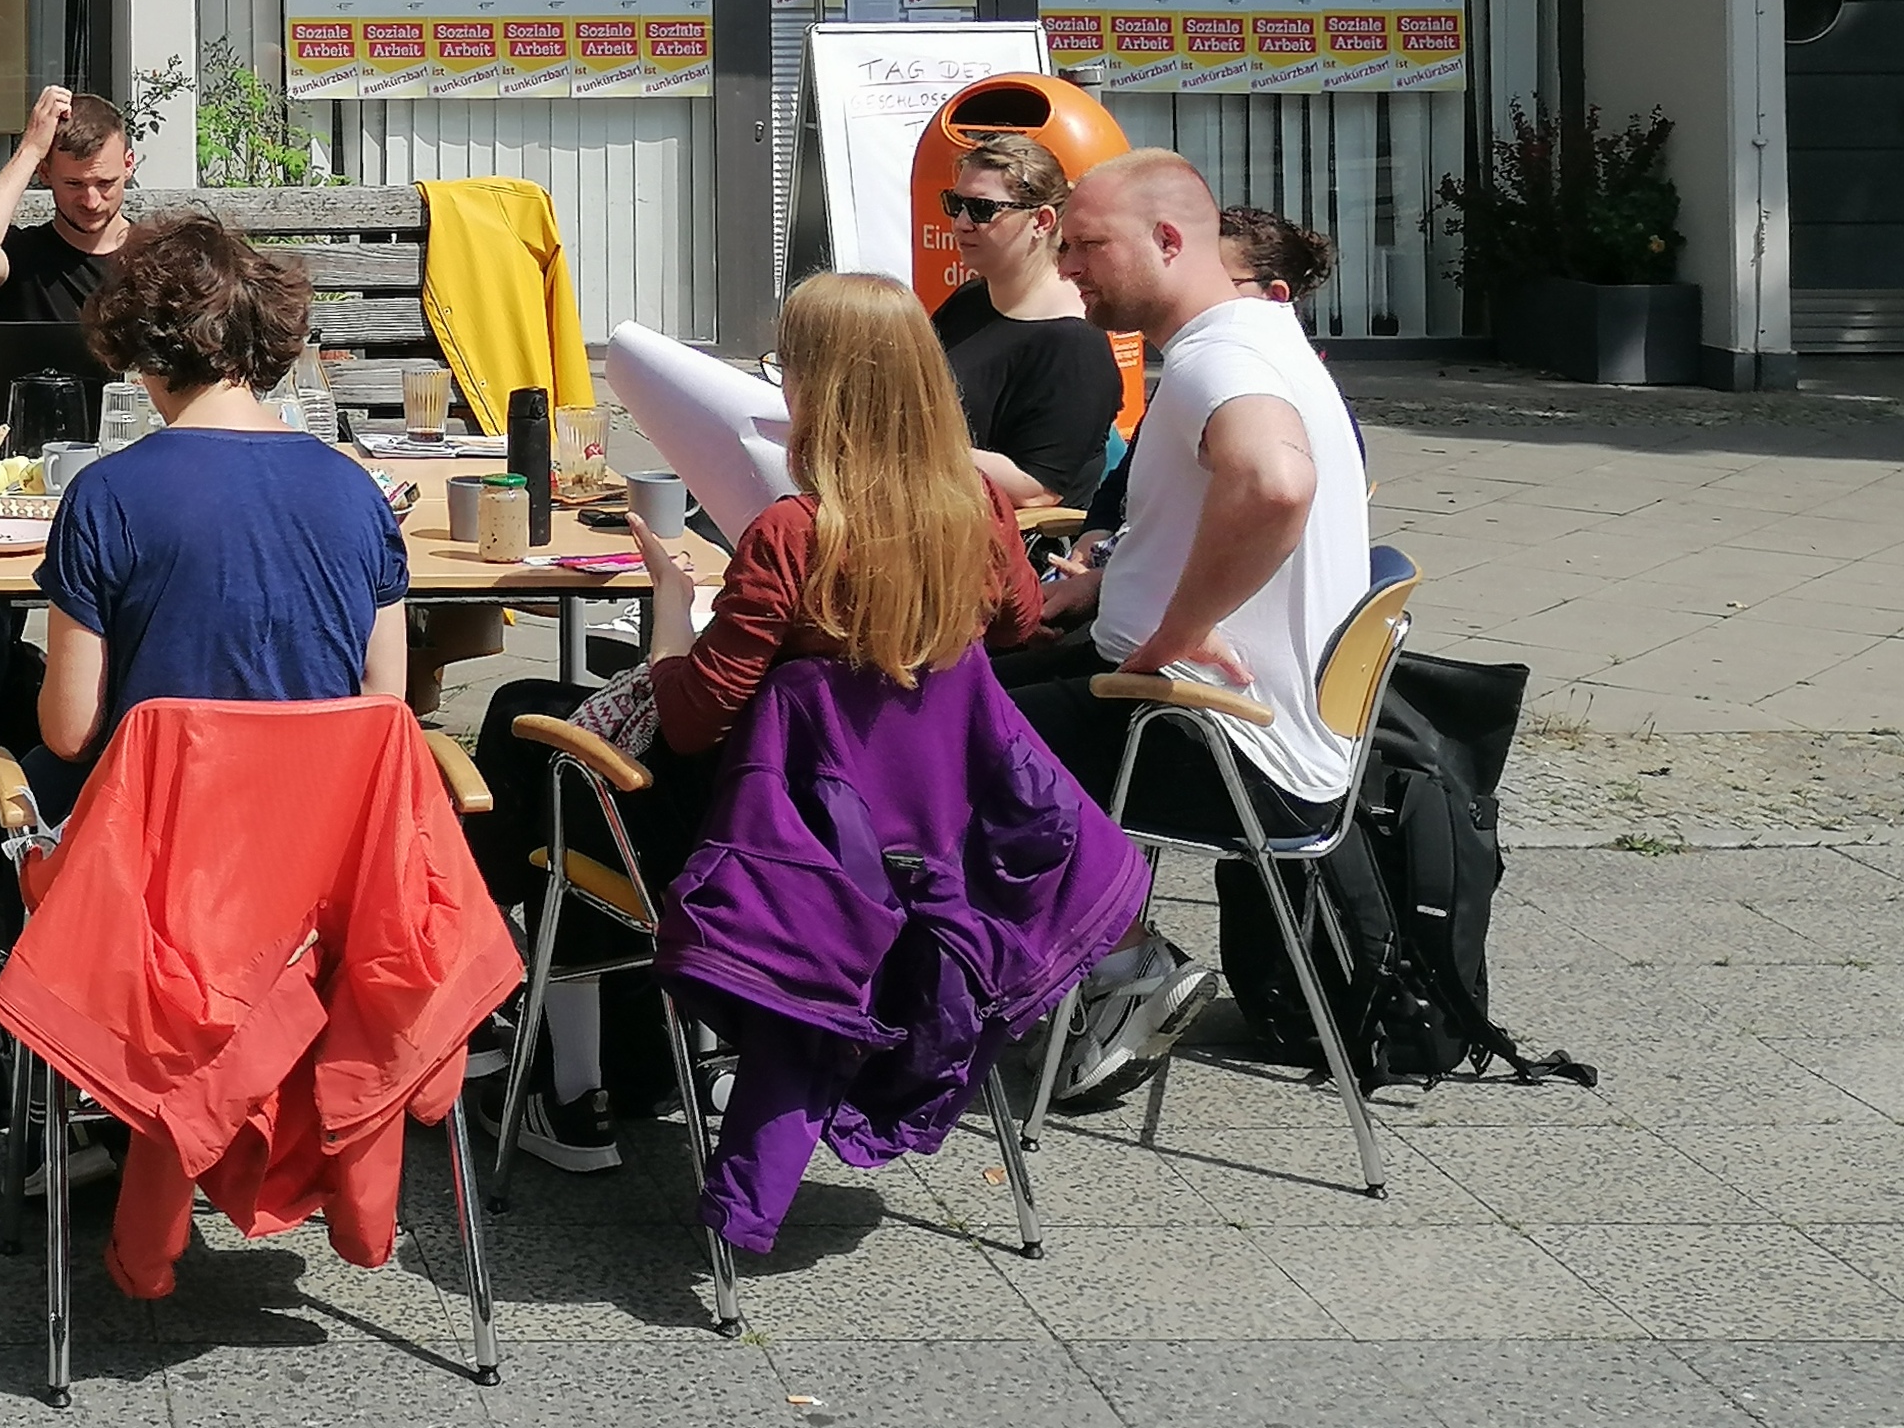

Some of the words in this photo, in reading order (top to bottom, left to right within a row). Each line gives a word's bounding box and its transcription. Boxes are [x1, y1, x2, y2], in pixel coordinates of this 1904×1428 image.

[507, 24, 560, 38] Soziale
[579, 24, 632, 38] Soziale
[649, 24, 702, 38] Soziale
[1045, 17, 1098, 31] Soziale
[1115, 19, 1168, 33] Soziale
[1186, 20, 1239, 34] Soziale
[1257, 20, 1310, 34] Soziale
[1329, 18, 1382, 32] Soziale
[1401, 18, 1454, 32] Soziale
[296, 26, 349, 40] Soziale
[366, 25, 419, 39] Soziale
[437, 25, 490, 39] Soziale
[514, 42, 562, 55] Arbeit
[586, 42, 634, 55] Arbeit
[656, 42, 704, 55] Arbeit
[1051, 35, 1100, 48] Arbeit
[1121, 36, 1170, 49] Arbeit
[1192, 38, 1241, 51] Arbeit
[1263, 38, 1312, 51] Arbeit
[1335, 36, 1384, 49] Arbeit
[1407, 36, 1456, 49] Arbeit
[303, 44, 351, 57] Arbeit
[373, 43, 421, 56] Arbeit
[444, 43, 492, 56] Arbeit
[858, 59, 925, 81] TAG
[939, 59, 992, 79] DER
[850, 93, 947, 111] GESCHLOSS
